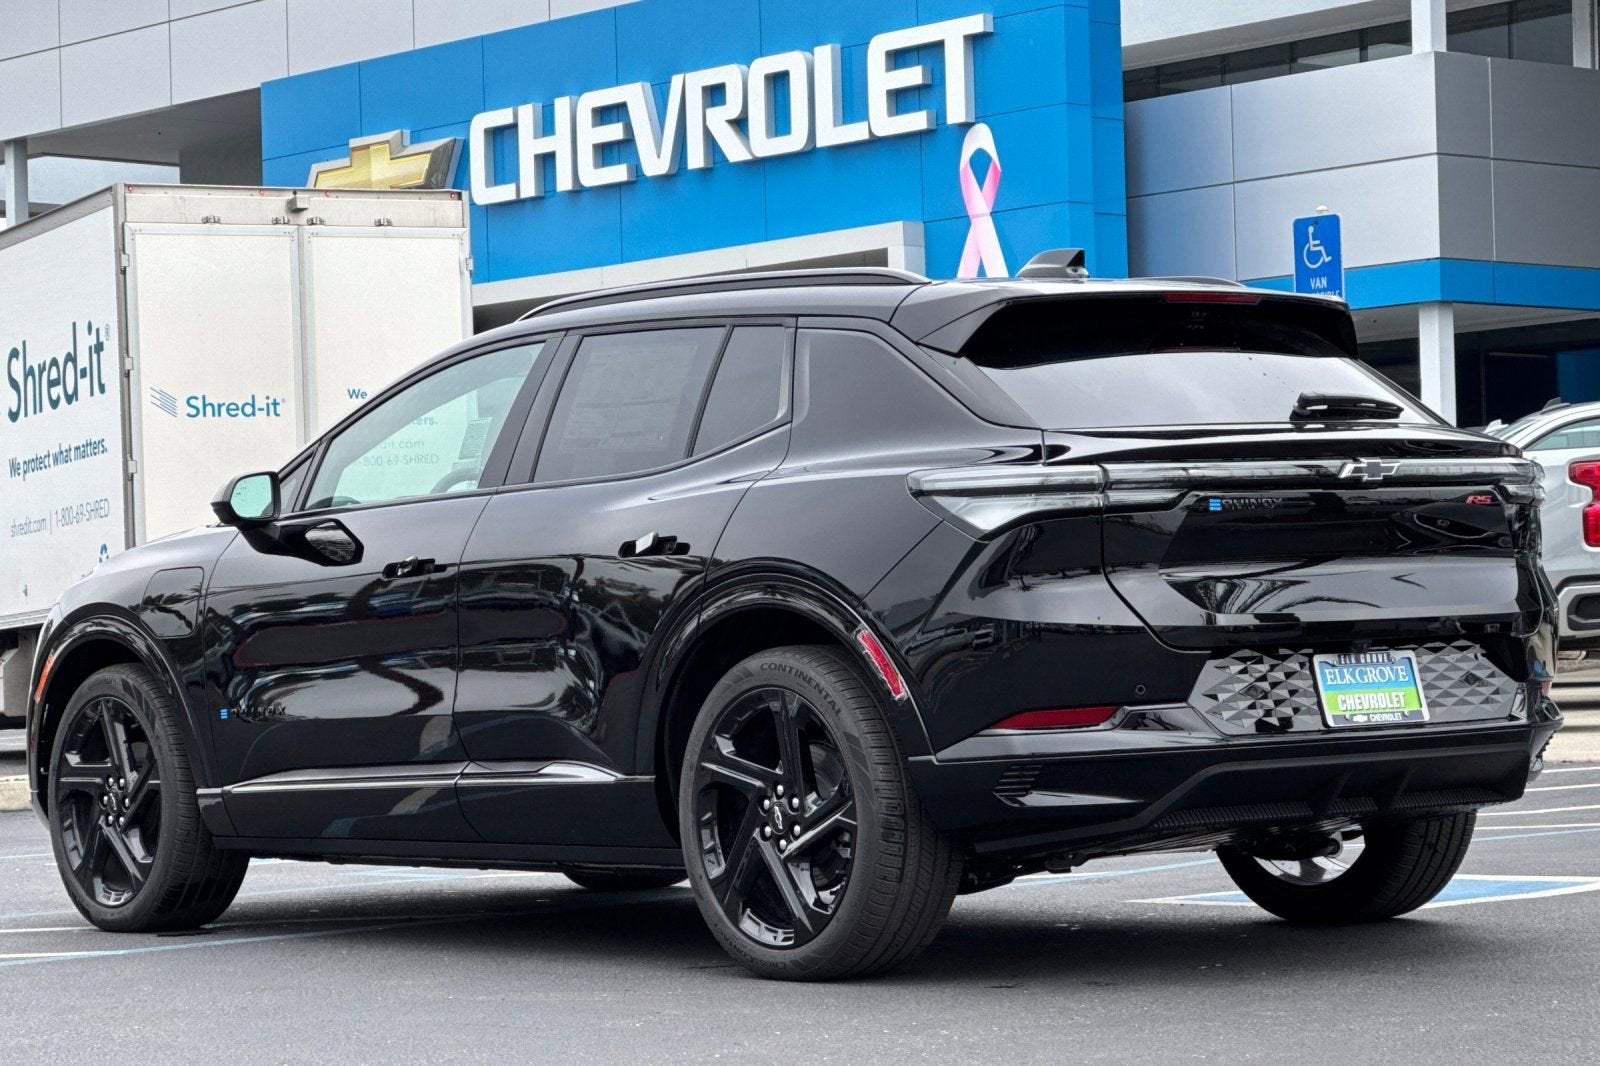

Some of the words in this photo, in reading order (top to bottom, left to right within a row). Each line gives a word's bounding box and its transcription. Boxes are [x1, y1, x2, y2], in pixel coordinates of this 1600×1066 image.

[469, 12, 994, 206] CHEVROLET
[1310, 276, 1327, 289] VAN
[7, 320, 105, 423] Shred-it
[347, 388, 368, 399] We
[186, 394, 280, 418] Shred-it
[8, 457, 21, 478] We
[22, 450, 51, 481] protect
[52, 443, 72, 467] what
[73, 438, 108, 461] matters.
[1466, 495, 1492, 504] RS
[10, 516, 47, 538] shredit.com
[55, 498, 110, 528] 1-800-69-SHRED
[1341, 654, 1356, 664] ELK
[1360, 653, 1388, 663] GROVE
[1325, 668, 1355, 685] ELK
[1355, 666, 1409, 683] GROVE
[760, 662, 842, 719] CONTINENTAL
[1337, 692, 1406, 711] CHEVROLET
[1369, 712, 1403, 722] CHEVROLET
